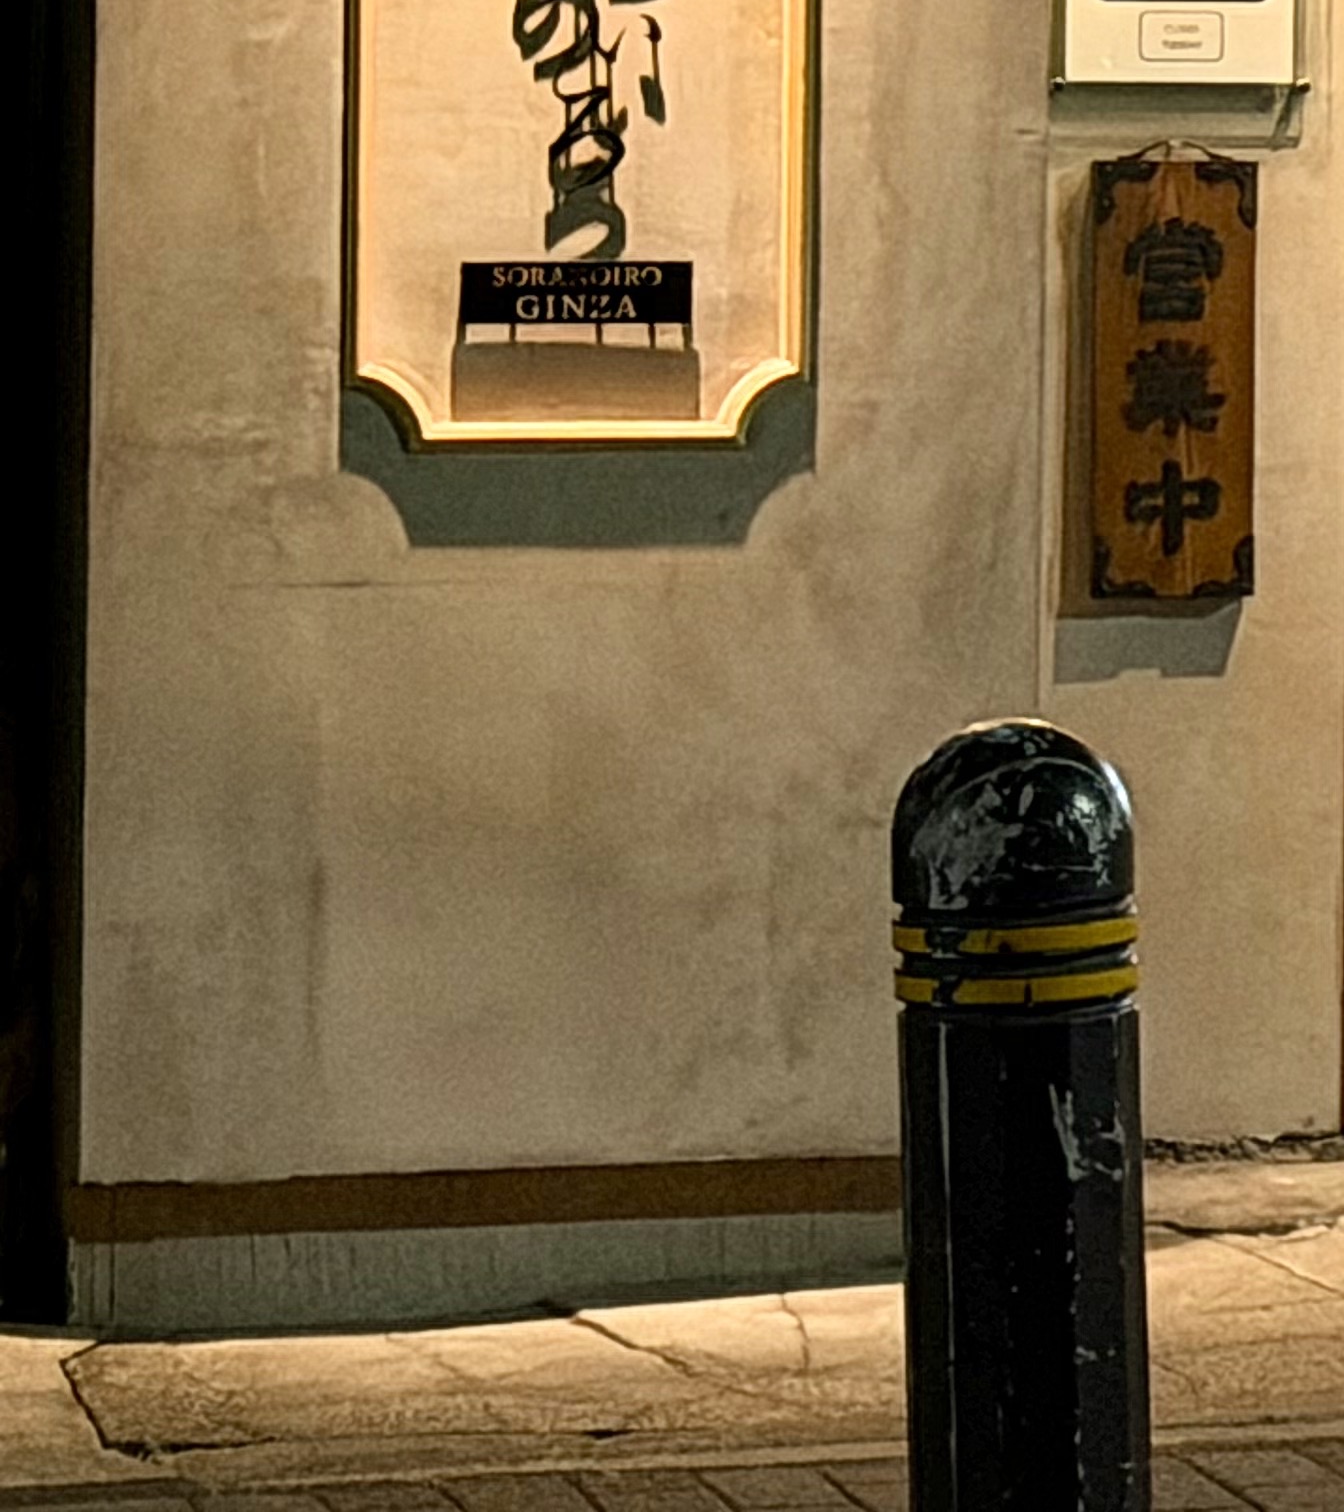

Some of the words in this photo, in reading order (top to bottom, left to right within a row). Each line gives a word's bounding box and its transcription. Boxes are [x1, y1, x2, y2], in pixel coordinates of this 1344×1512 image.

[515, 294, 638, 320] GINZA
[1122, 217, 1228, 558] 営業中
